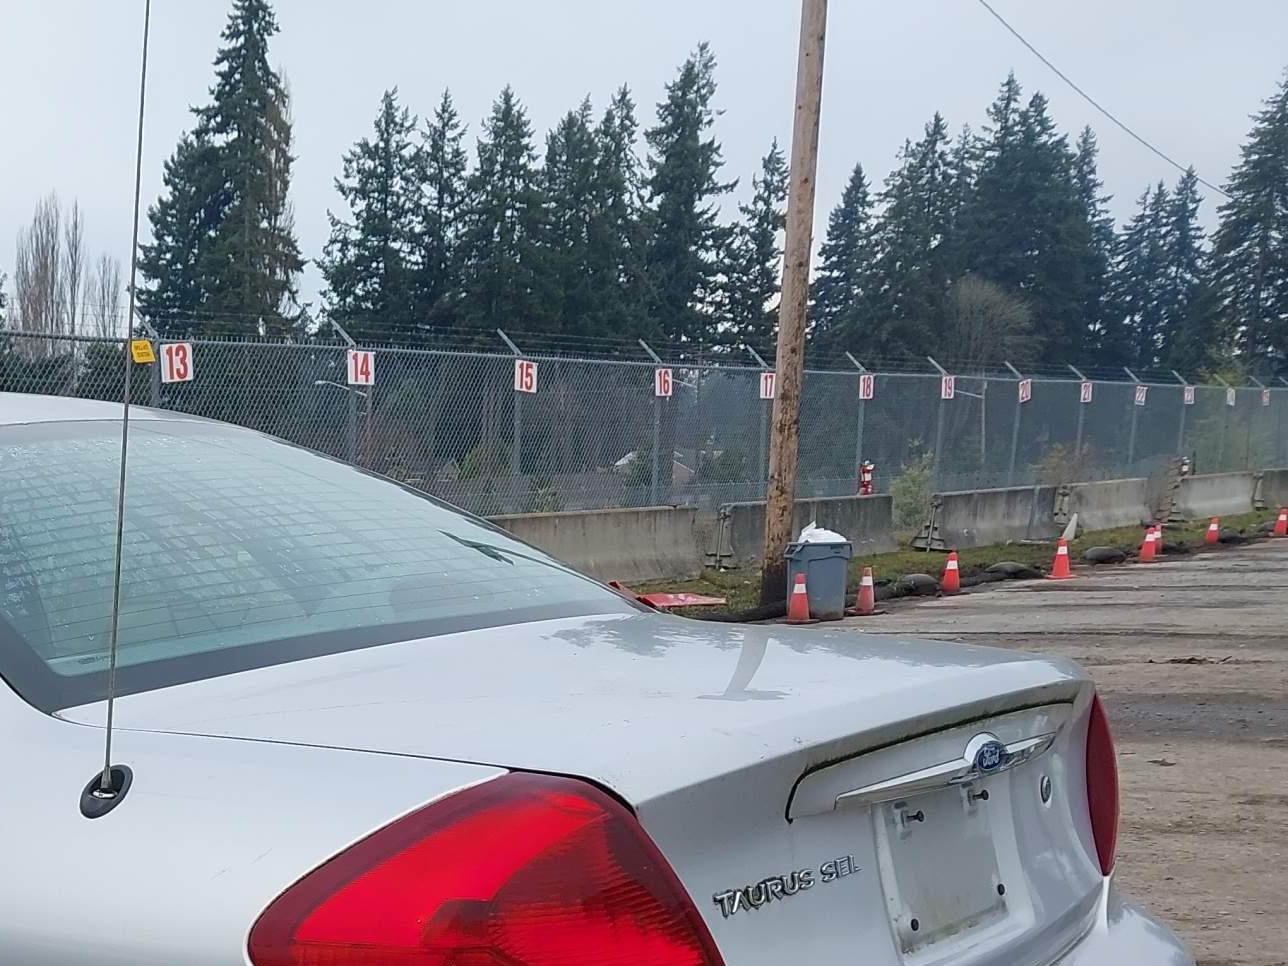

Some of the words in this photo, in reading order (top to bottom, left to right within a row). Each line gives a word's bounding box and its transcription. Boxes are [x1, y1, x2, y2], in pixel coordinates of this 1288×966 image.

[165, 344, 189, 380] 13
[352, 351, 371, 384] 14
[518, 361, 534, 391] 15
[658, 369, 670, 395] 16
[764, 373, 775, 398] 17
[862, 375, 873, 398] 18
[943, 377, 953, 398] 19
[981, 746, 1001, 767] Ford
[713, 868, 816, 920] TAURUS
[819, 853, 863, 884] SEL
